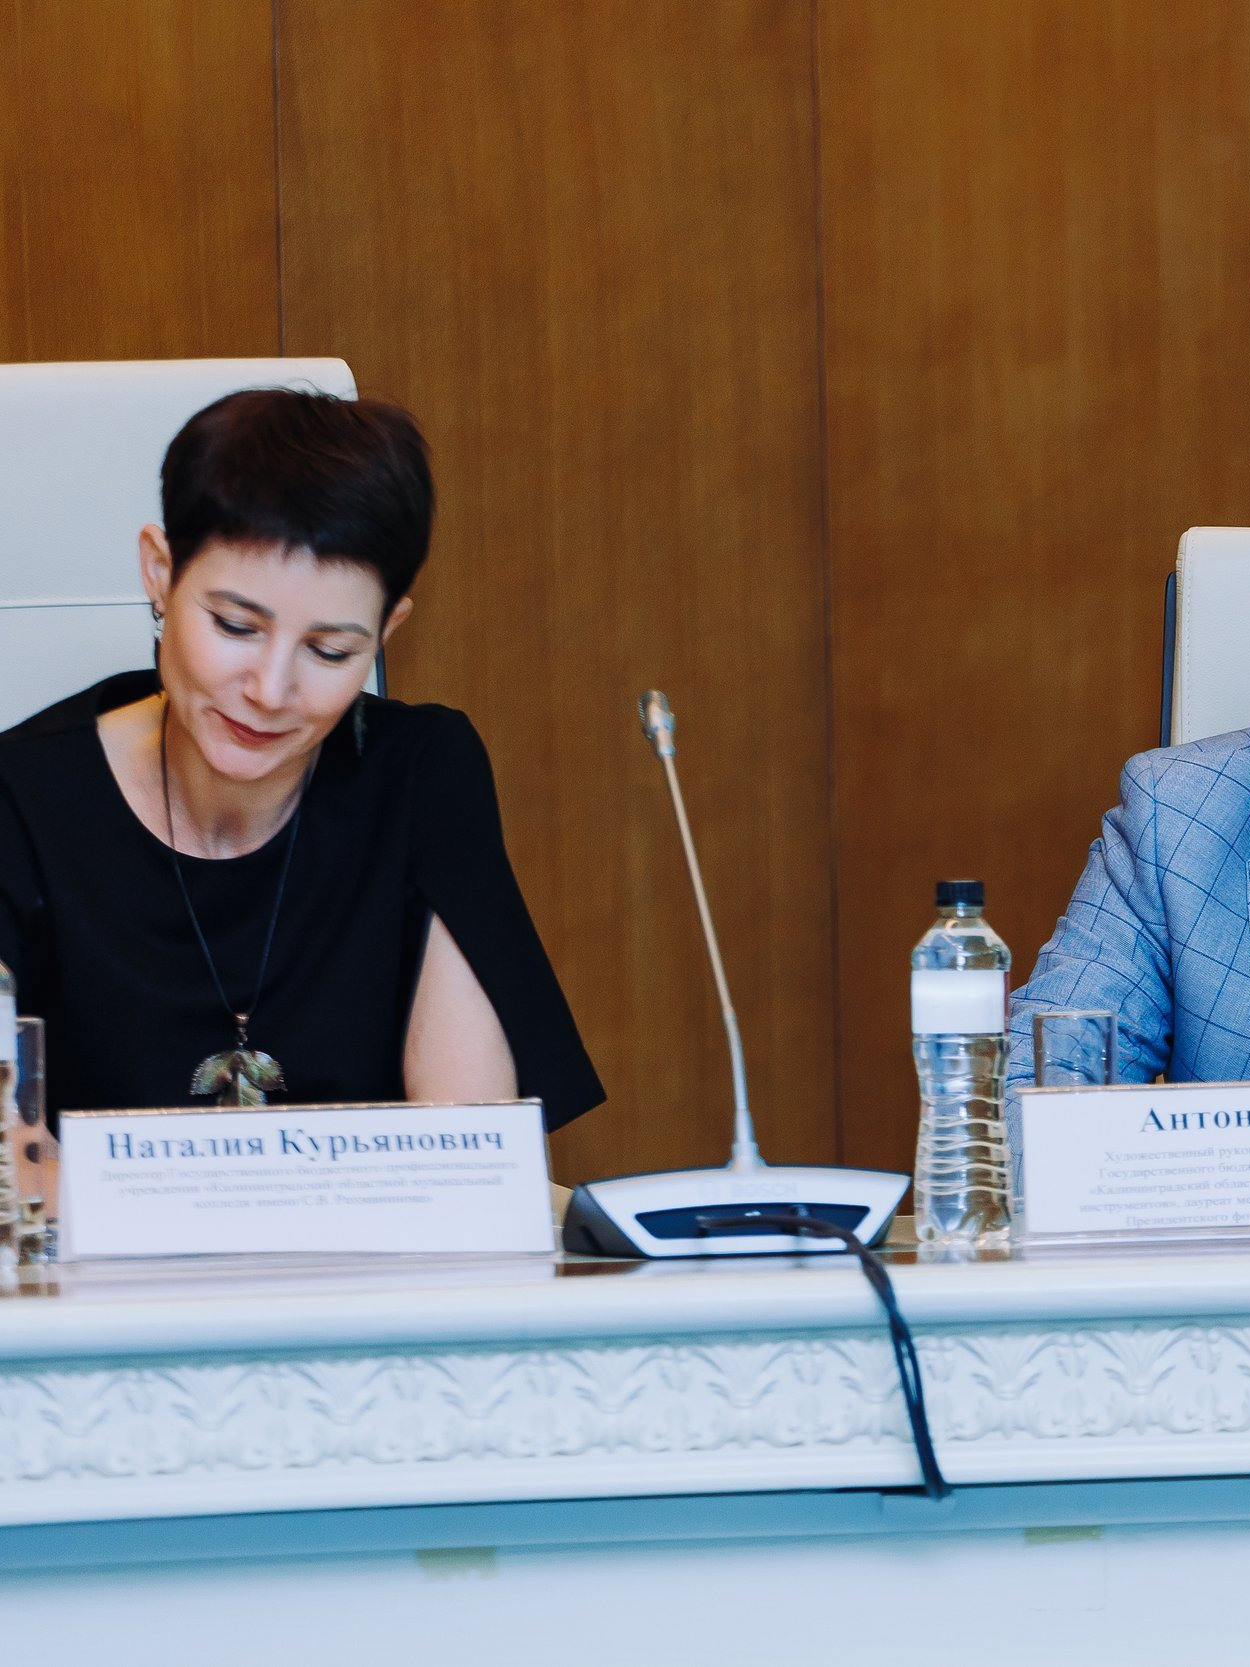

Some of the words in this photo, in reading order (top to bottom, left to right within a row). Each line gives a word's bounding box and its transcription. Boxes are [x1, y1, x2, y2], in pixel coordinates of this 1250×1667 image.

[105, 1131, 267, 1160] Наталия
[278, 1128, 505, 1162] Курьянович
[1103, 1146, 1215, 1163] Художественный
[1097, 1164, 1215, 1180] Государственного
[1183, 1197, 1232, 1209] лауреат
[1125, 1213, 1229, 1229] Президентского
